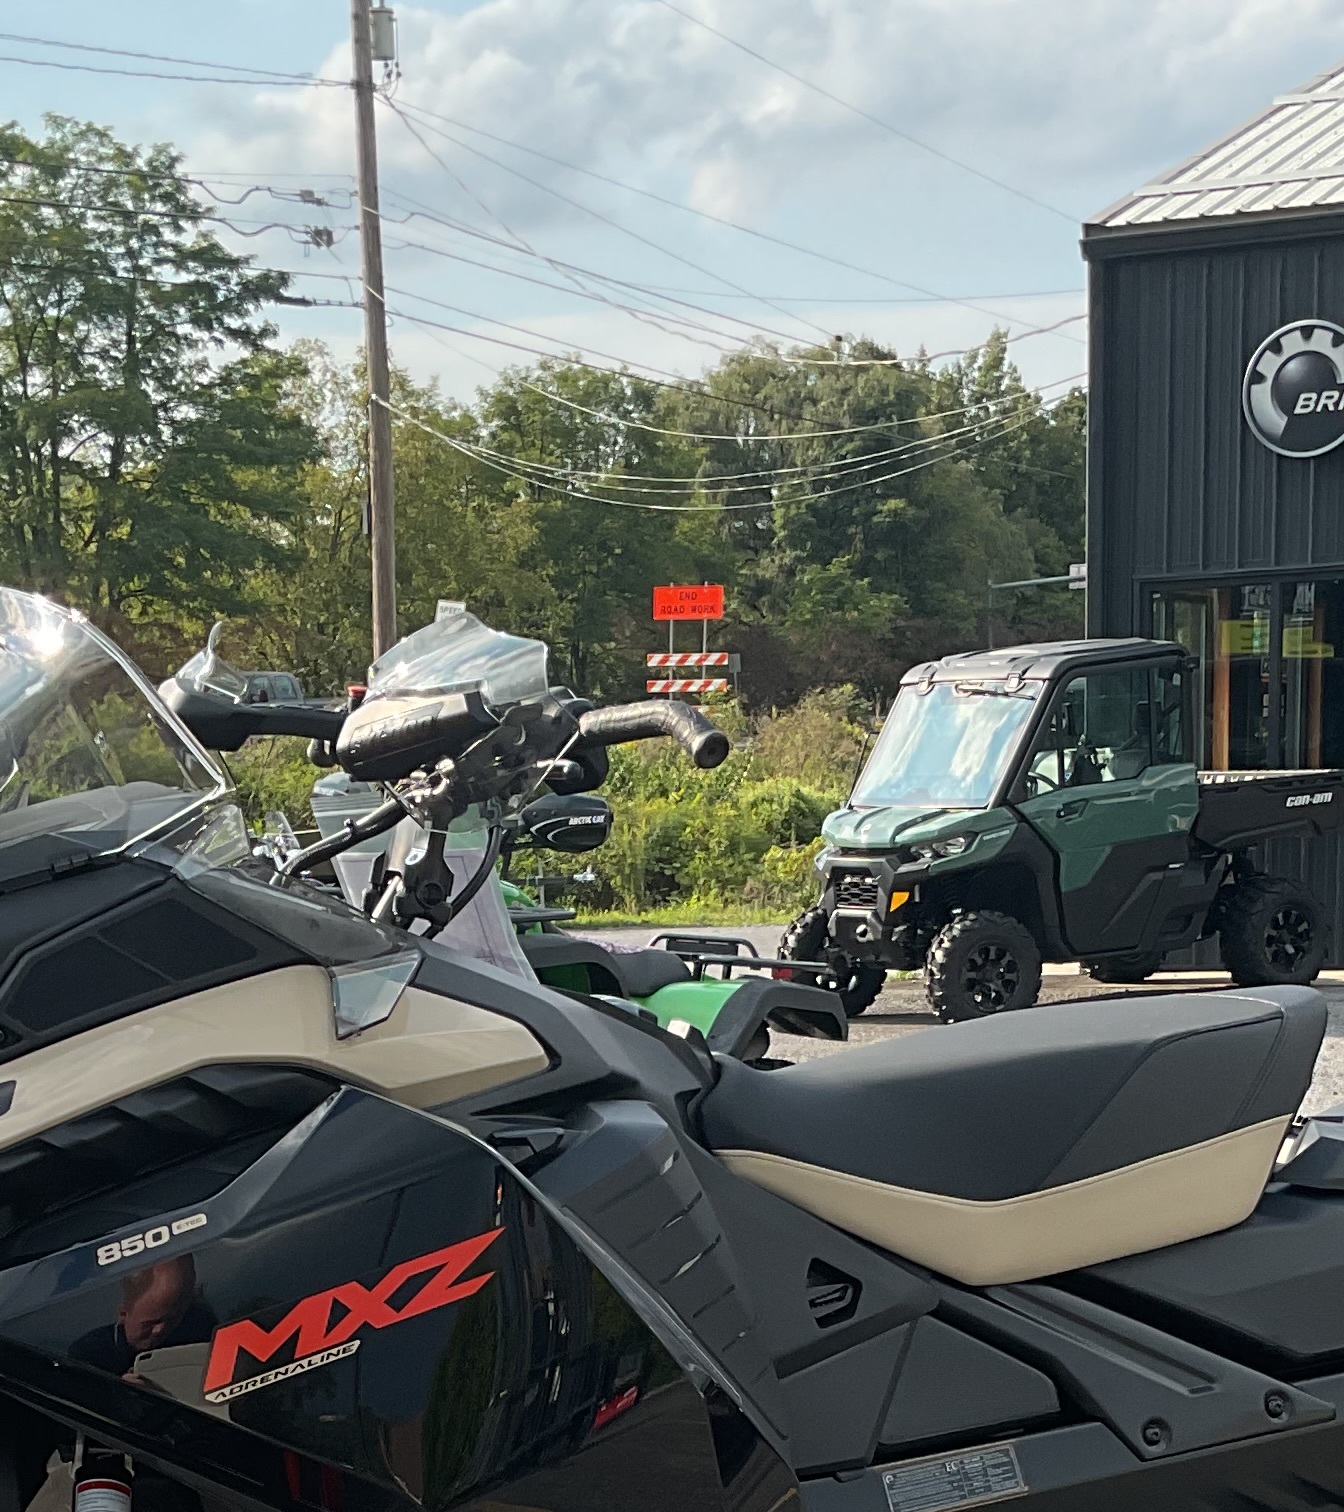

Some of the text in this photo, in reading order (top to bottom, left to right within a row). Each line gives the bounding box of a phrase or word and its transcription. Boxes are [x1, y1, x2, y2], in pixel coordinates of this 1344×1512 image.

[660, 603, 716, 615] ROAD WORK
[678, 591, 698, 601] END
[1285, 791, 1333, 808] can-am
[96, 1225, 170, 1266] 850
[203, 1226, 506, 1393] MXZ
[213, 1343, 358, 1401] ADRENALINE
